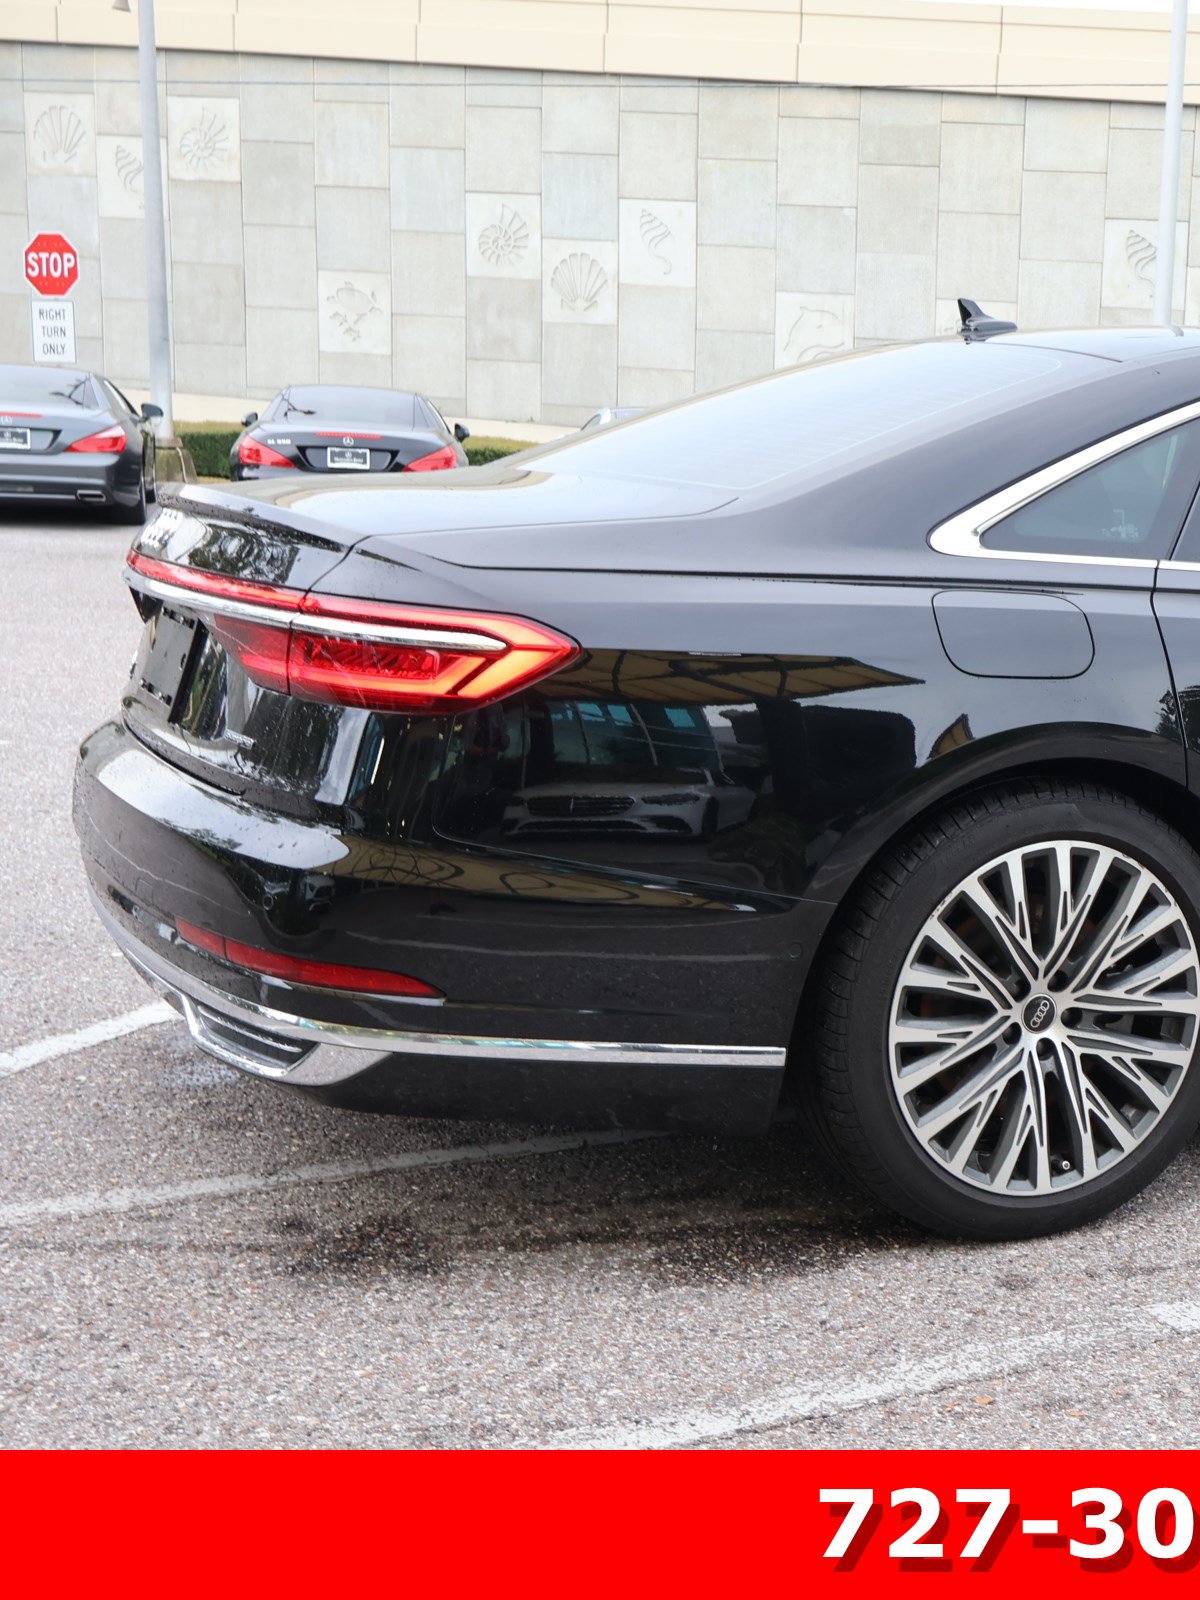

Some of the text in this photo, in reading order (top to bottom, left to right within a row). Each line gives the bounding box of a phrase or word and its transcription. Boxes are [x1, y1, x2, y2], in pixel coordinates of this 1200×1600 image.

[27, 251, 75, 278] STOP
[38, 308, 67, 321] RIGHT
[41, 326, 67, 338] TURN
[42, 343, 67, 356] ONLY
